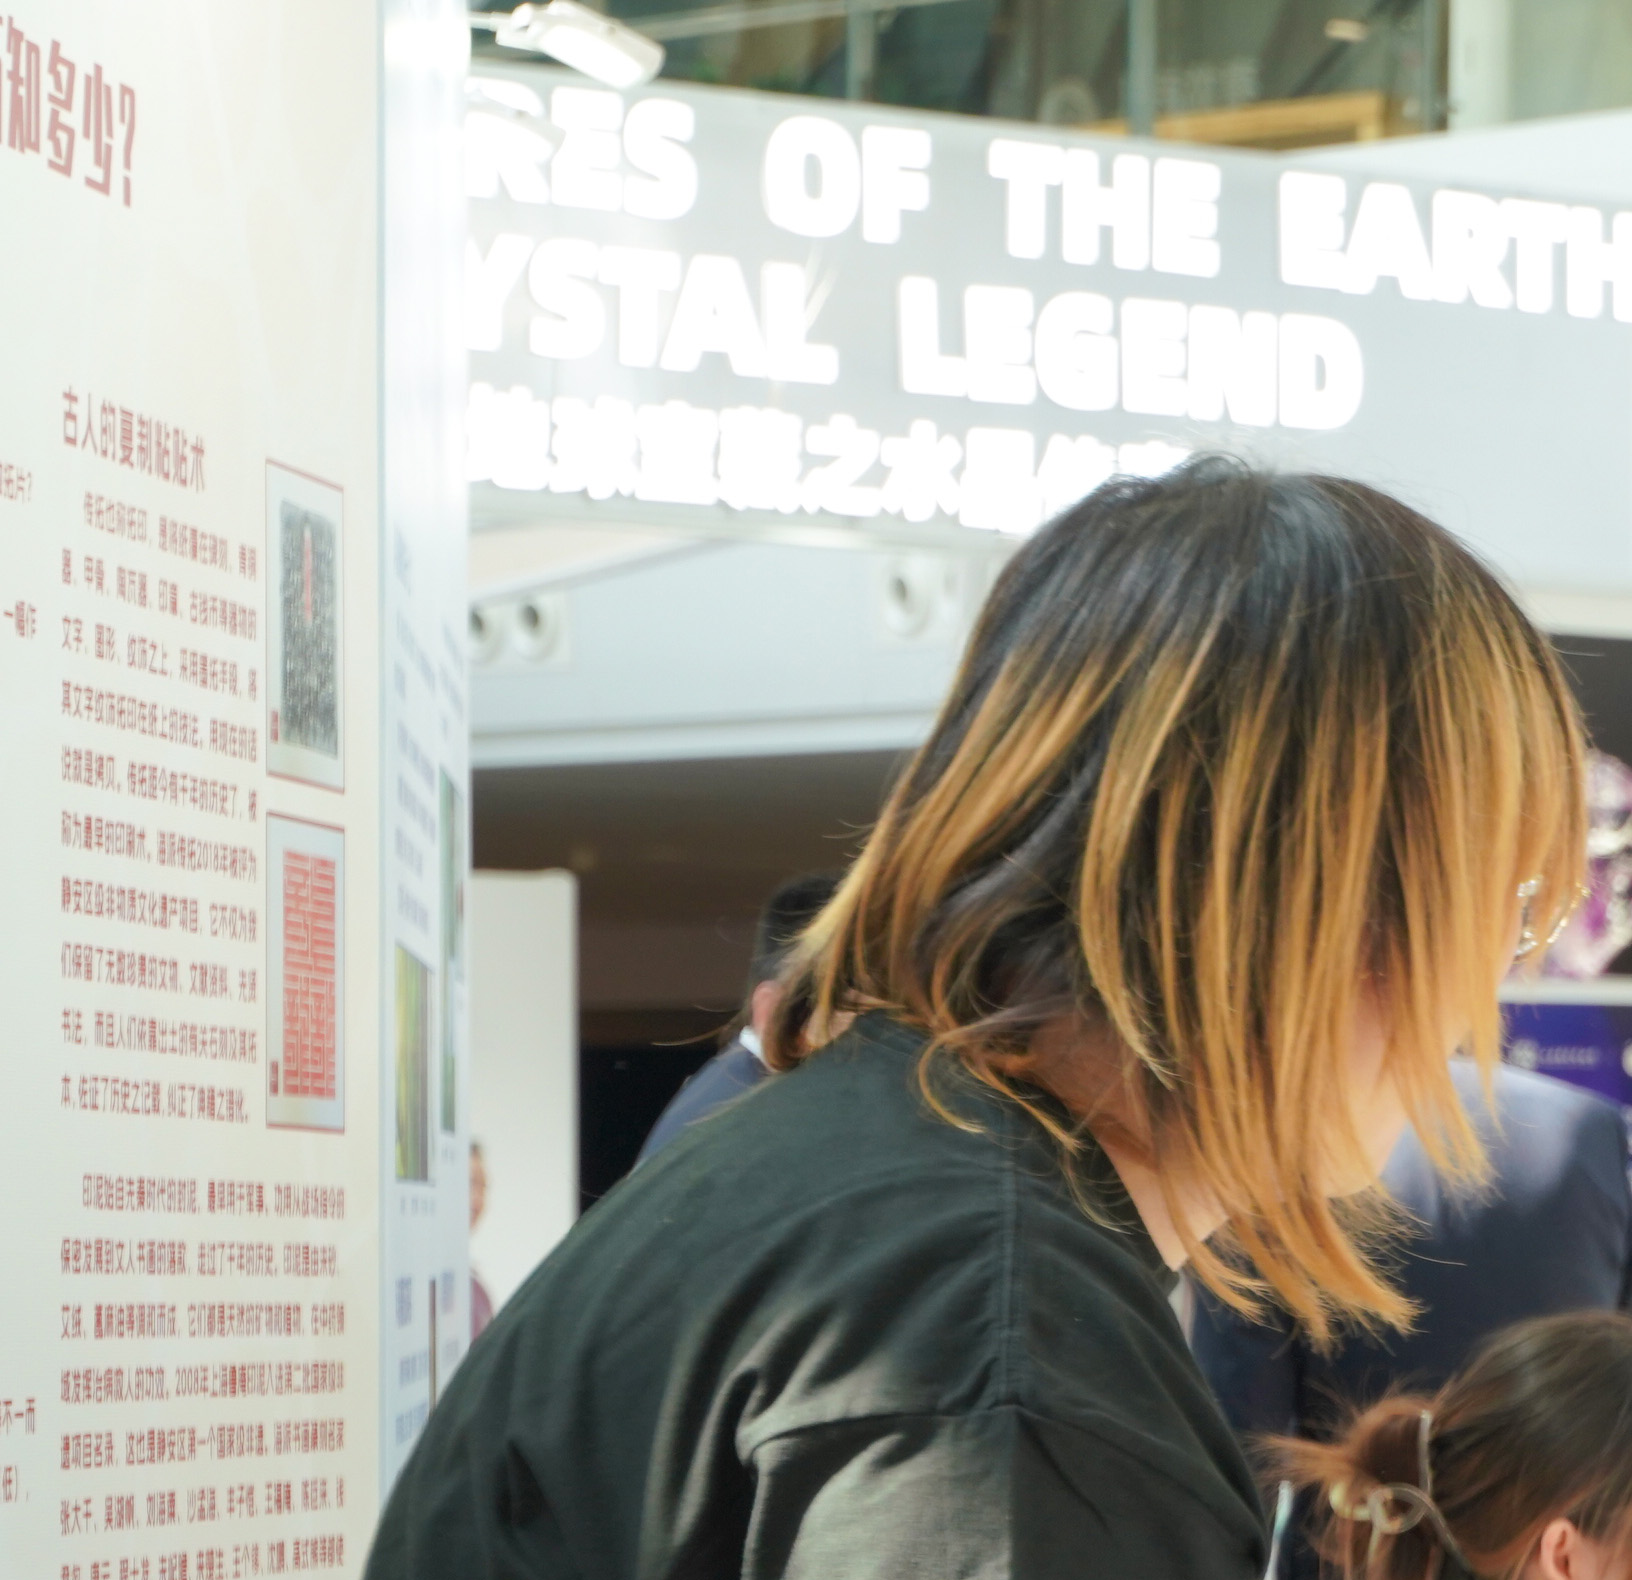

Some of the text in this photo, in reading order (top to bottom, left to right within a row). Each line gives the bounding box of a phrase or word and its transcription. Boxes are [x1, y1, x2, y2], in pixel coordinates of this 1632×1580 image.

[0, 15, 136, 209] 知多少？
[760, 115, 932, 245] OF
[987, 137, 1222, 279] THE
[898, 275, 1364, 431] LEGEND
[62, 386, 206, 492] 古人的复制粘贴术
